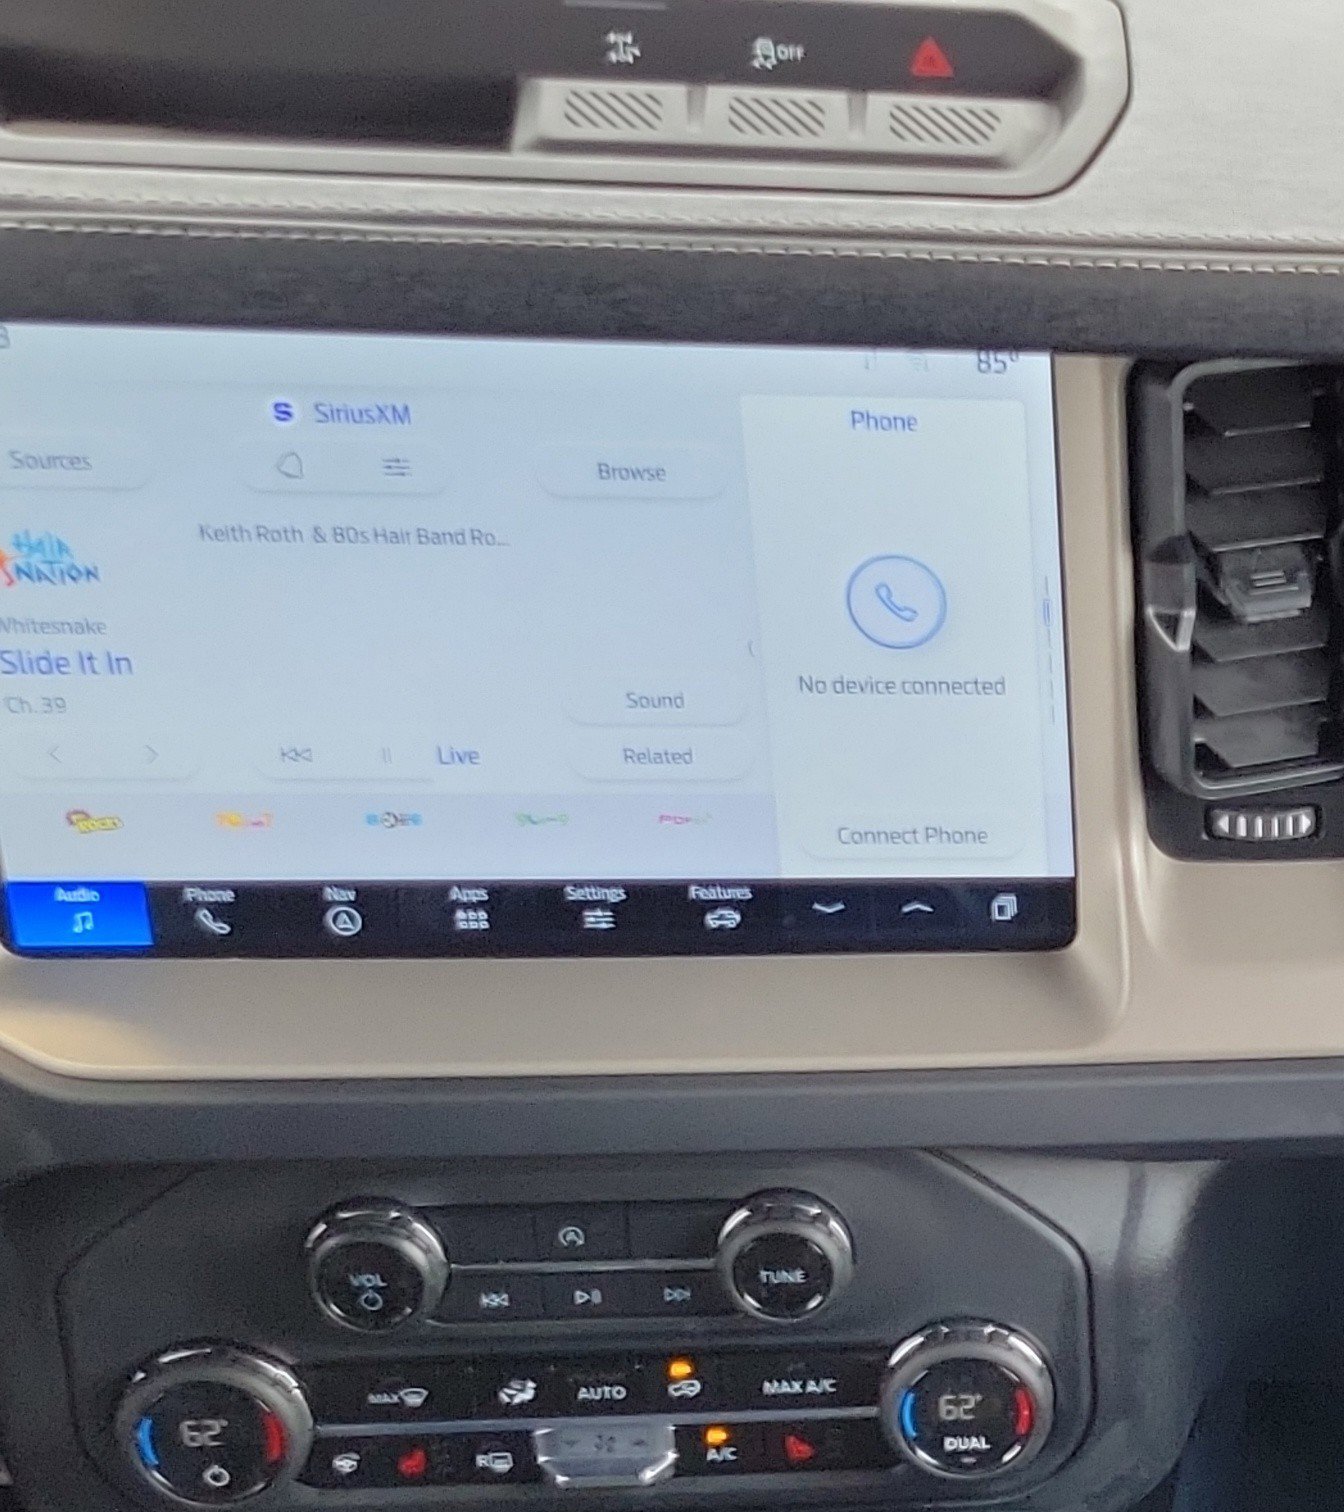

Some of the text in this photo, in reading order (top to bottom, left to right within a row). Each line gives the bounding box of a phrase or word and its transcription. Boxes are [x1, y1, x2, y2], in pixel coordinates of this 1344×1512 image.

[313, 402, 413, 426] SiriusXM
[850, 409, 919, 433] Phone
[9, 450, 93, 471] Sources
[596, 462, 667, 483] Browse
[200, 523, 252, 543] Keith
[254, 524, 303, 544] Roth
[312, 526, 326, 545] &
[373, 527, 412, 546] Hair
[416, 527, 468, 547] Band
[0, 651, 134, 676] Slide It In
[799, 674, 1007, 697] No device connected
[42, 696, 67, 715] 39
[626, 690, 685, 710] Sound
[436, 746, 482, 766] Live
[622, 746, 694, 766] Related
[837, 825, 989, 847] Connect Phone
[54, 885, 101, 904] Audio
[183, 886, 236, 903] Phone
[323, 884, 357, 903] Nav
[449, 885, 490, 906] Apps
[564, 884, 628, 904] Settings
[688, 884, 753, 902] Features
[349, 1272, 387, 1289] VOL
[759, 1268, 808, 1286] TUNE
[577, 1384, 628, 1402] AUTO
[762, 1377, 838, 1397] MAX A/C
[943, 1435, 992, 1453] DUAL
[706, 1446, 737, 1463] A/C
